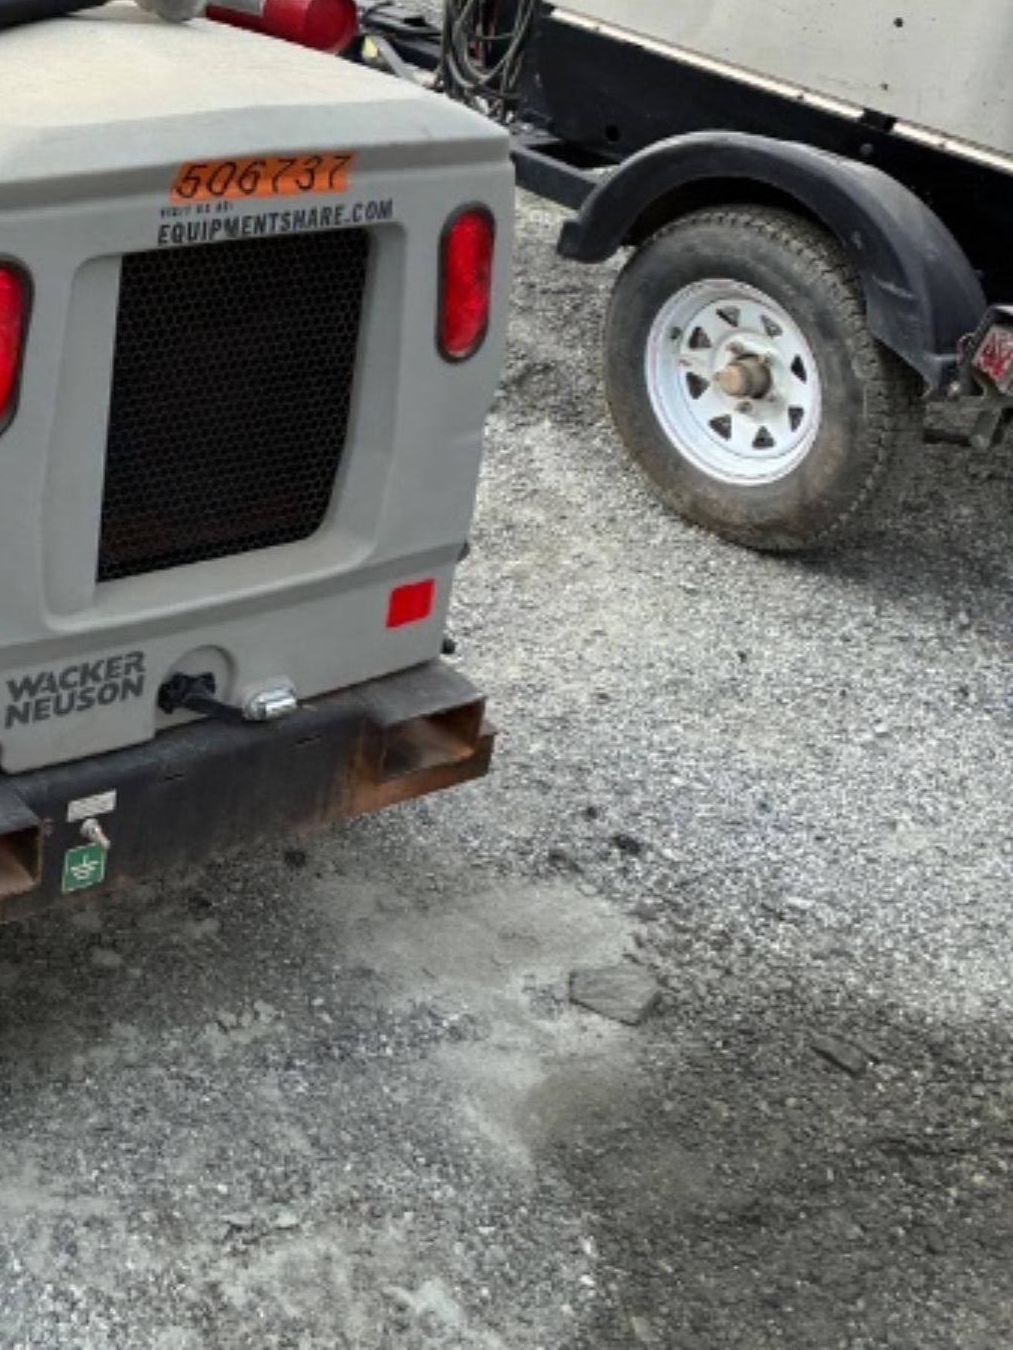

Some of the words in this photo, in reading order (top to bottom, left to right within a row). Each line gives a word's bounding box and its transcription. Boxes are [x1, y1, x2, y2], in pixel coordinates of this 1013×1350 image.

[175, 154, 352, 199] 506737
[158, 198, 394, 245] EQUIPMENTSHARE.COM
[6, 650, 146, 701] WACKER
[4, 674, 145, 729] NEUSON
